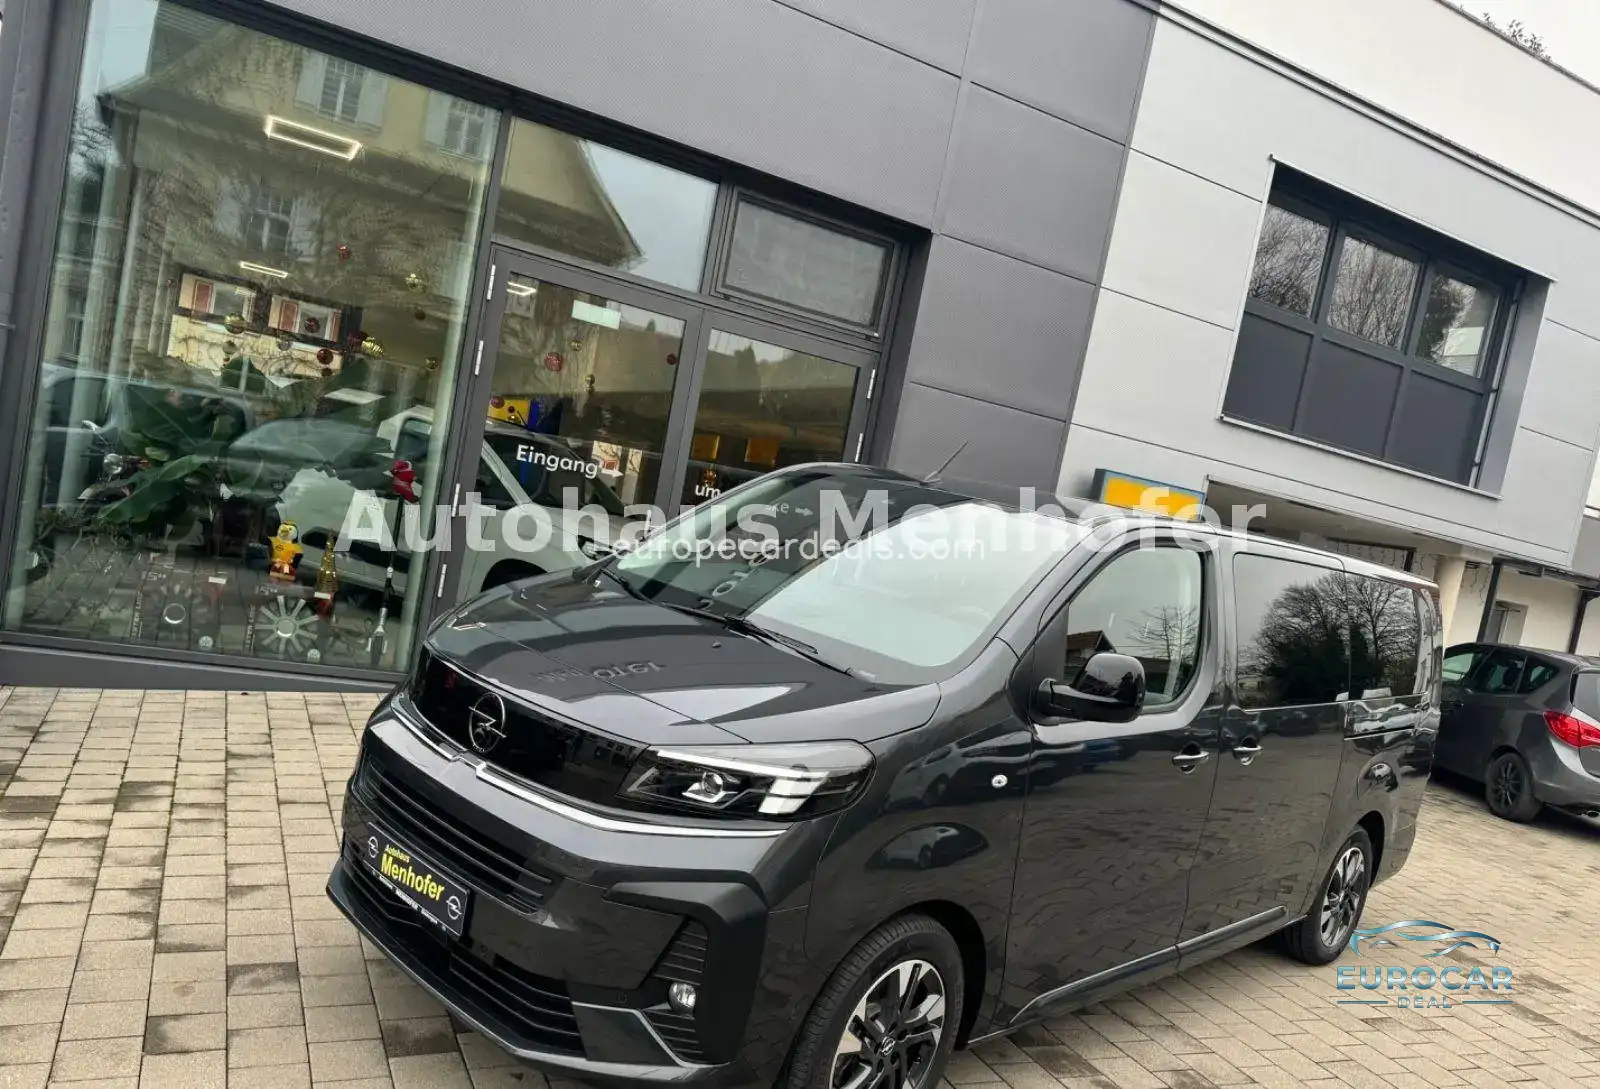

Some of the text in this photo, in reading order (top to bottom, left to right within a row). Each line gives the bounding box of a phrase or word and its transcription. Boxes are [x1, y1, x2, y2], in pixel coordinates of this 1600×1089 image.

[516, 444, 598, 479] Eingang
[695, 484, 721, 498] um
[384, 844, 410, 863] Autohaus
[381, 853, 445, 901] Menhofer
